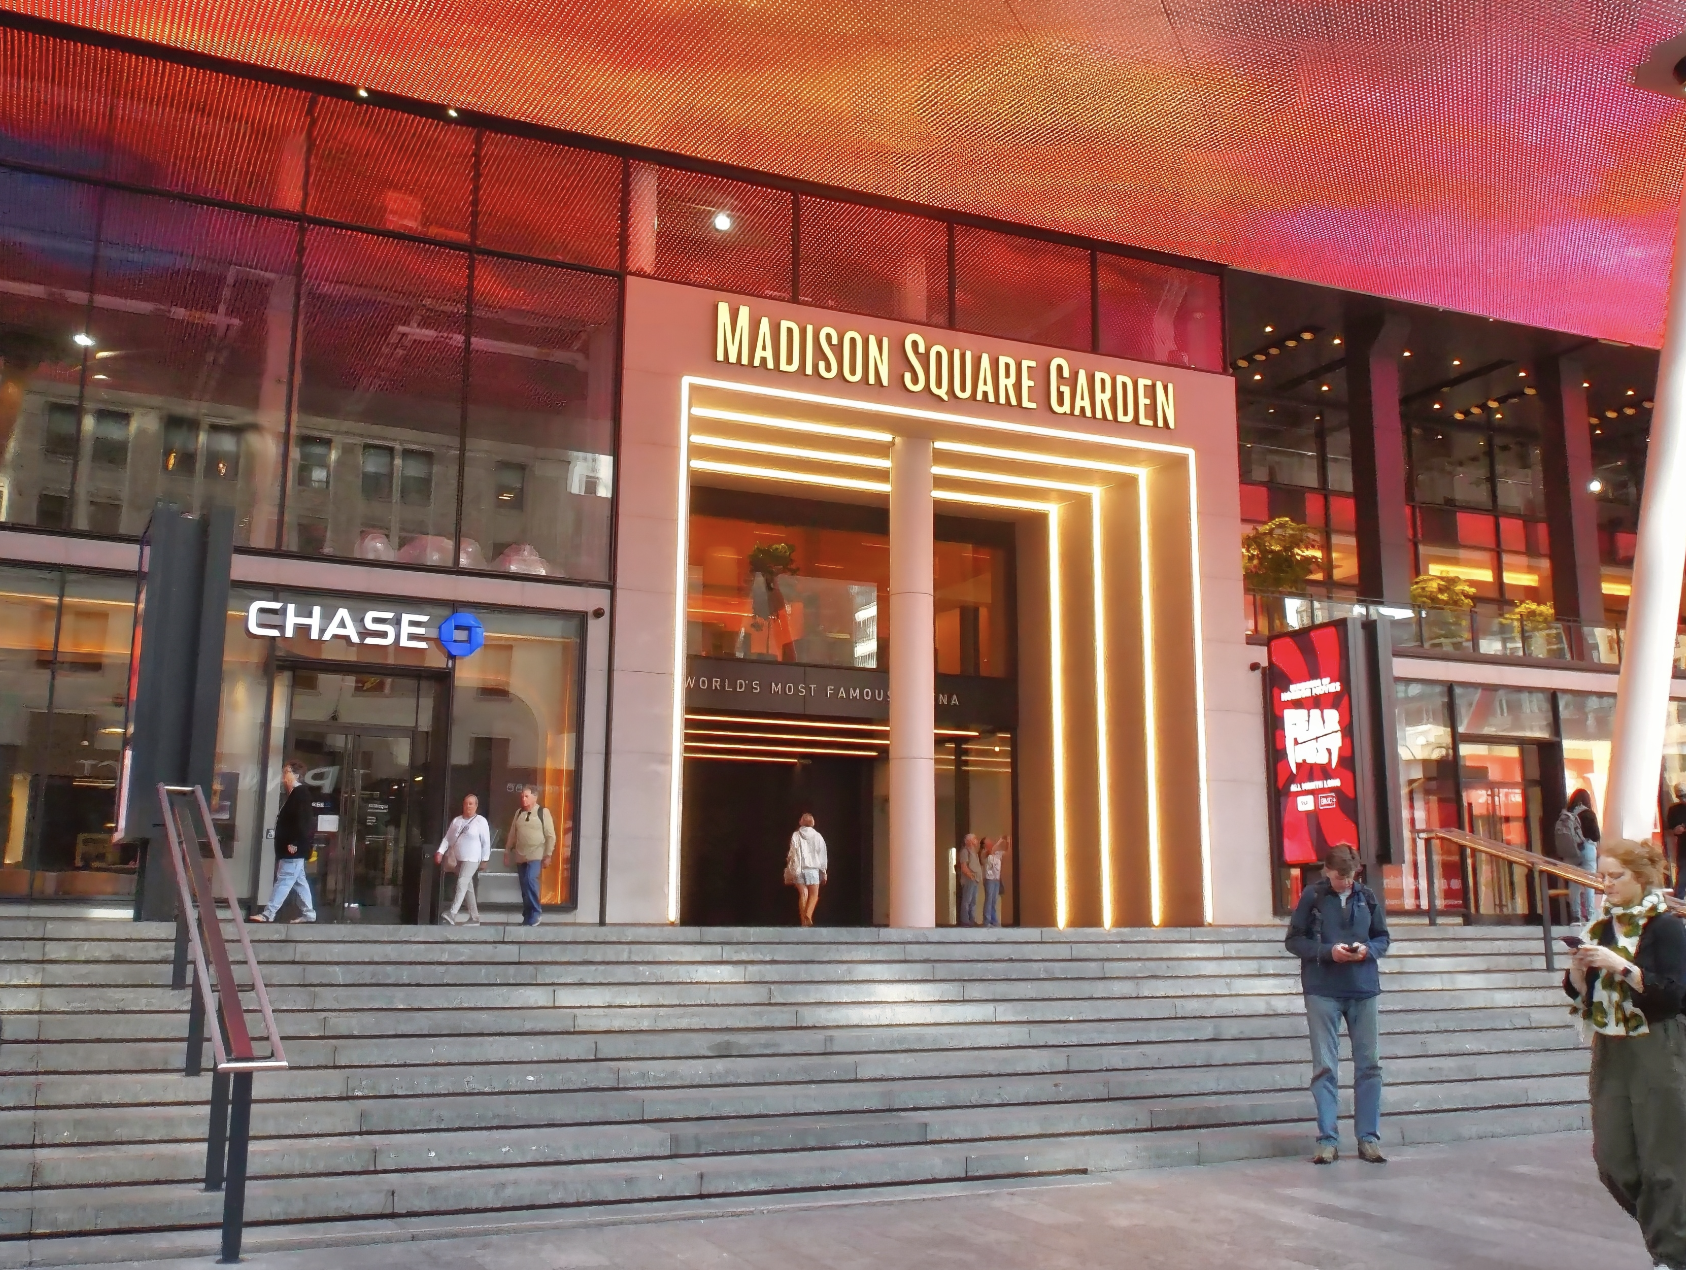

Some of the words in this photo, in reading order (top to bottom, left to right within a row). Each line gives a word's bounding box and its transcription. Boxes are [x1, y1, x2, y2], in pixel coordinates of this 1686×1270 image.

[715, 301, 889, 388] MADISON
[903, 333, 1038, 410] SQUARE
[1049, 357, 1176, 430] GARDEN
[247, 600, 430, 649] CHASE
[685, 676, 760, 693] WORLD'S
[771, 682, 817, 697] MOST
[1283, 708, 1341, 754] FEAR
